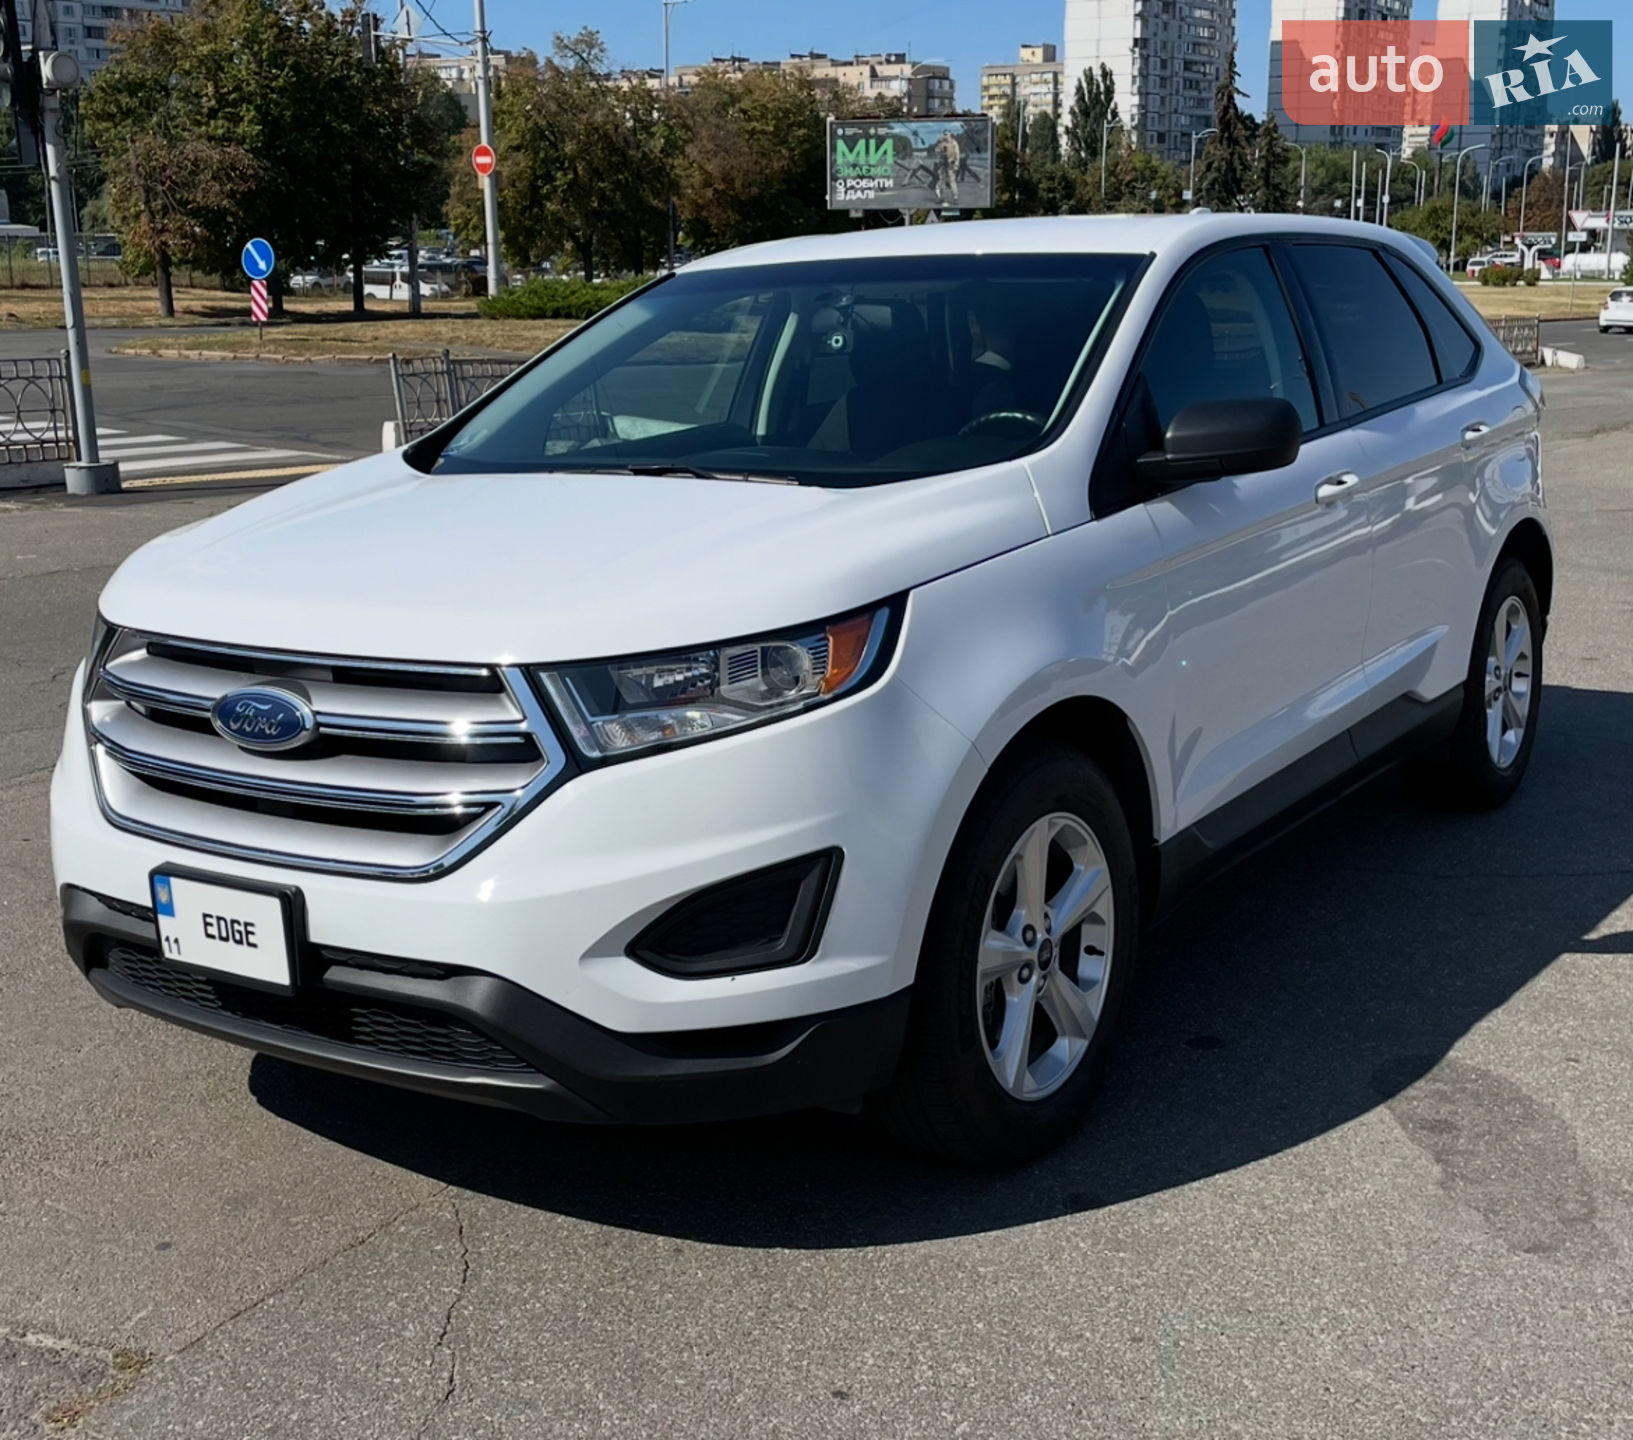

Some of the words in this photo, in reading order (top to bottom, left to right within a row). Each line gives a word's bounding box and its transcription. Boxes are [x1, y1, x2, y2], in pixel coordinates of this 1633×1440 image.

[837, 139, 893, 165] МИ
[846, 178, 894, 188] РОБИТИ
[846, 189, 875, 200] ДАЛІ
[229, 699, 285, 736] Ford
[202, 912, 258, 949] EDGE
[164, 935, 181, 956] 11
